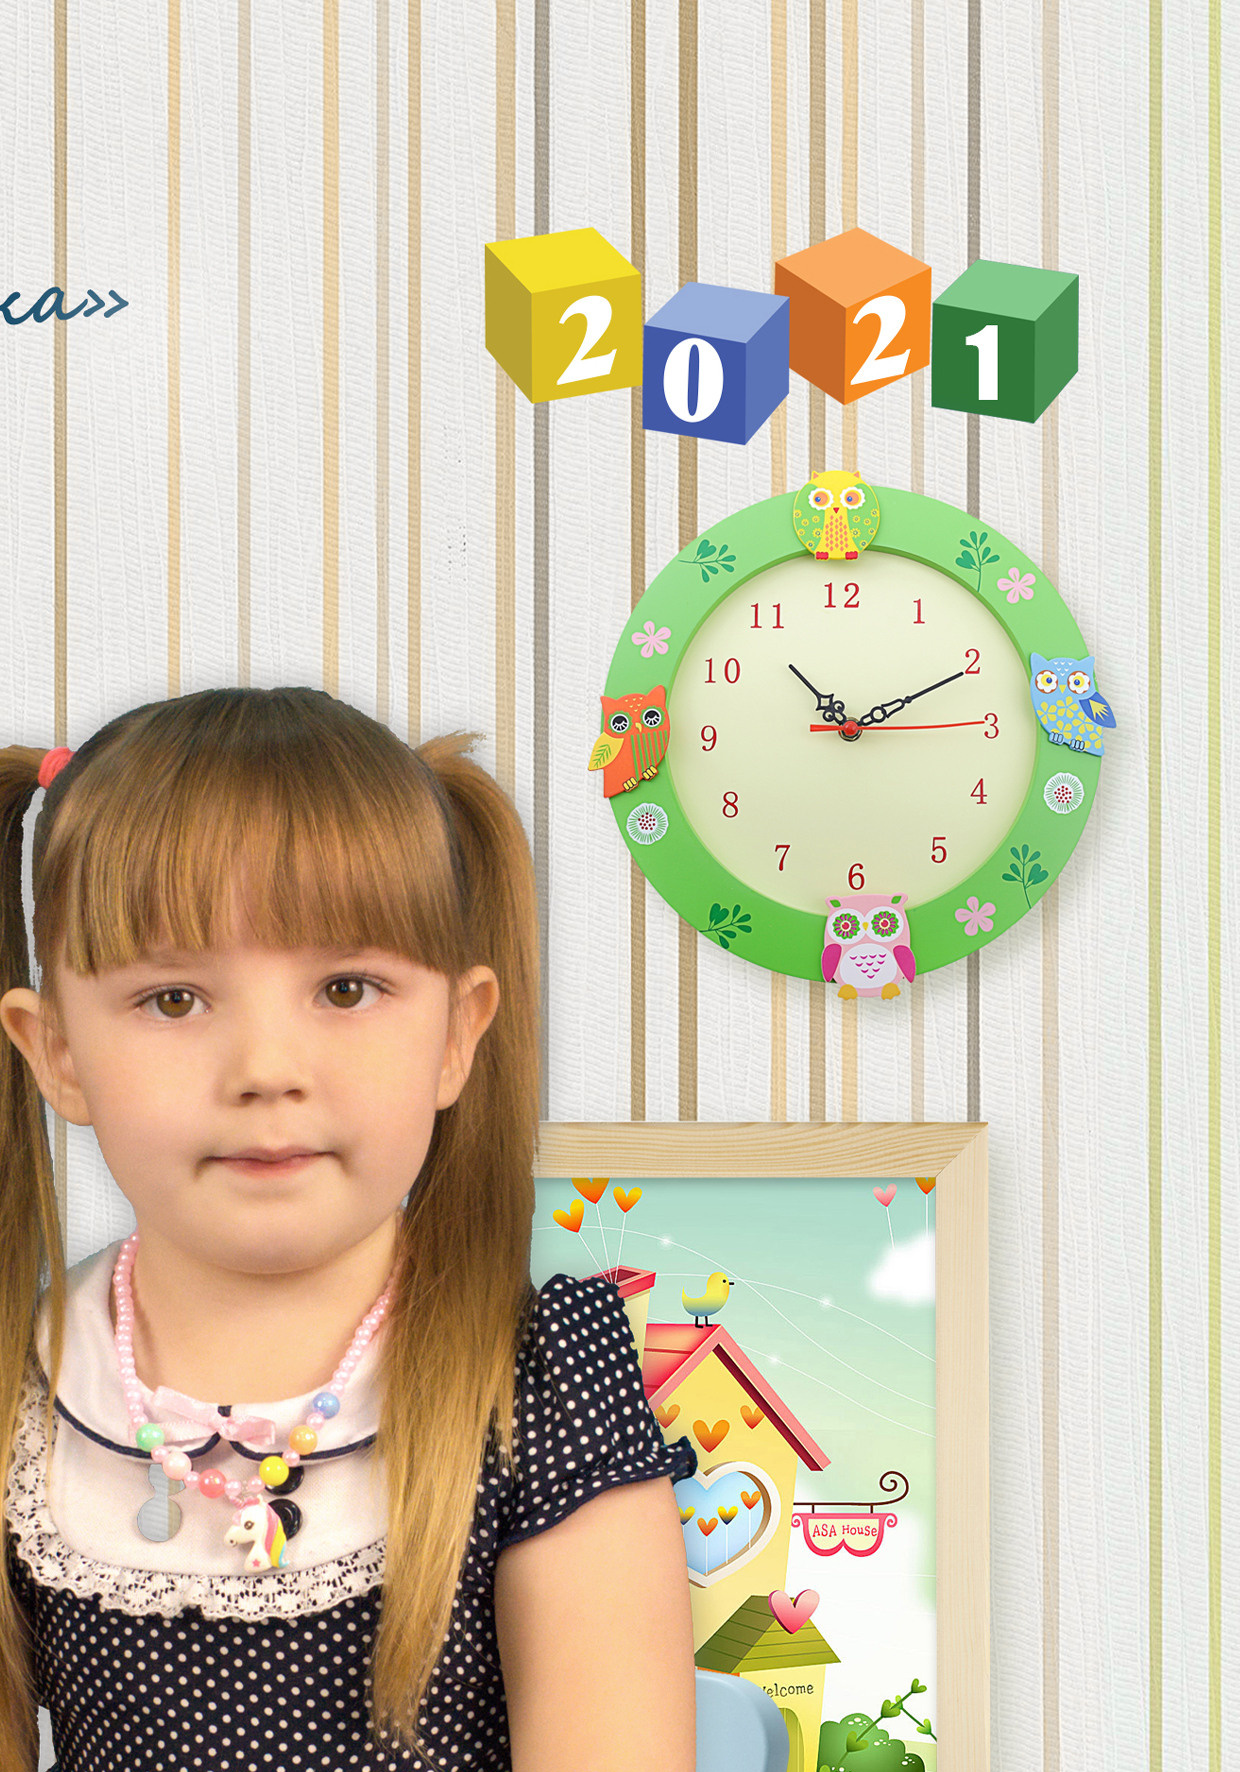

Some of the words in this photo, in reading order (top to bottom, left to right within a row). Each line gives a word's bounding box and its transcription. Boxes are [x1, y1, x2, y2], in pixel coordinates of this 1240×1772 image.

[824, 582, 861, 609] 12
[749, 603, 785, 630] 11
[912, 598, 926, 625] 1
[704, 657, 741, 684] 10
[963, 649, 982, 675] 2
[700, 725, 718, 752] 9
[983, 713, 1000, 740] 3
[721, 792, 739, 818] 8
[969, 778, 988, 805] 4
[774, 844, 791, 871] 7
[930, 836, 948, 864] 5
[847, 863, 865, 890] 6
[812, 1524, 837, 1538] ASA
[841, 1524, 878, 1537] House
